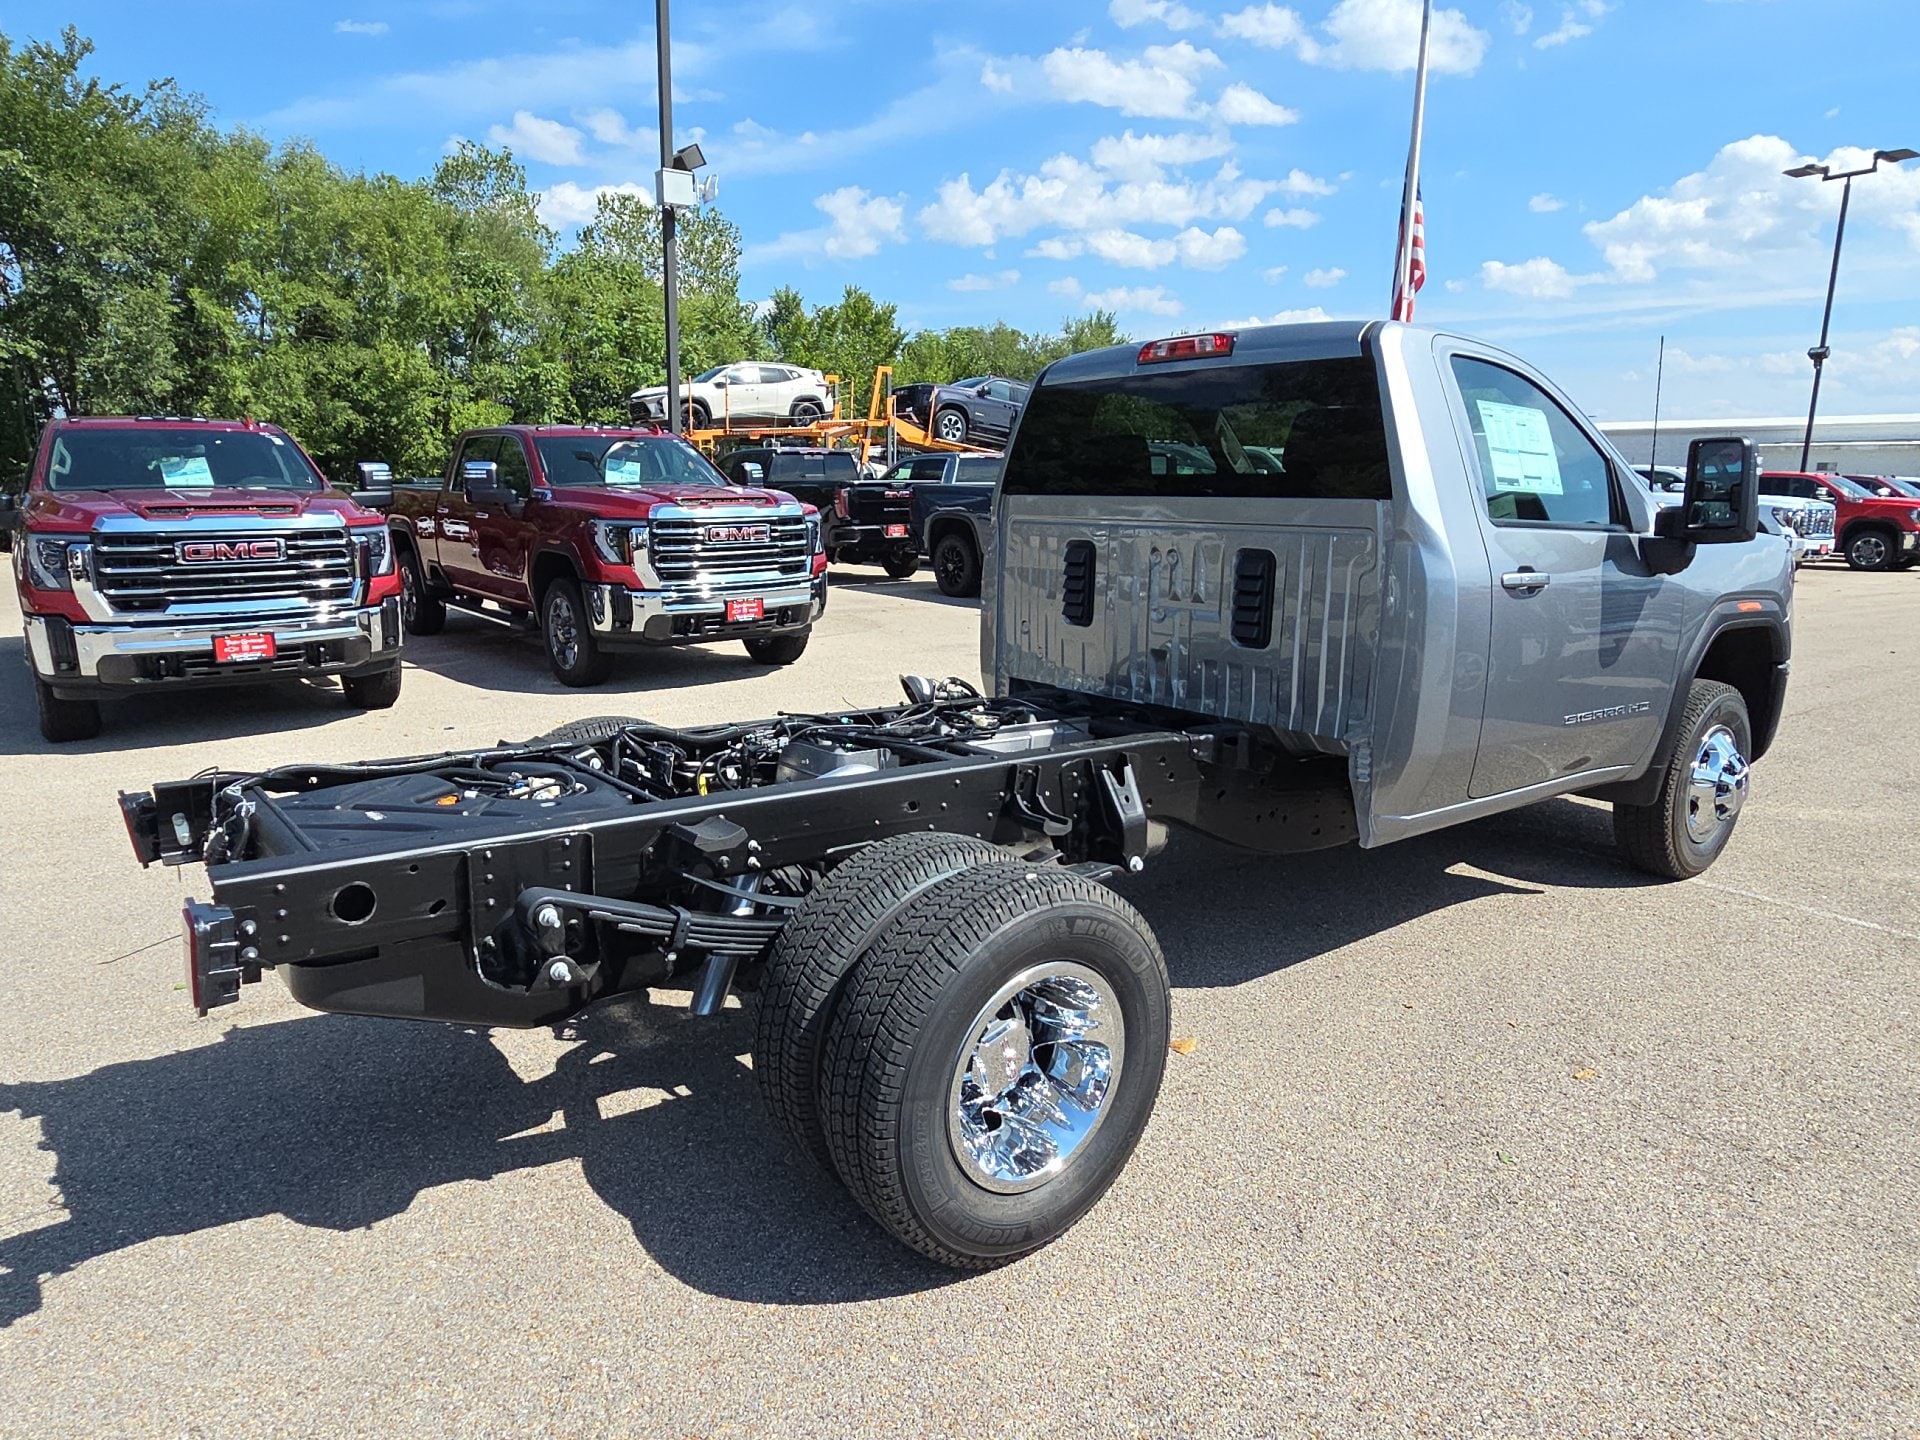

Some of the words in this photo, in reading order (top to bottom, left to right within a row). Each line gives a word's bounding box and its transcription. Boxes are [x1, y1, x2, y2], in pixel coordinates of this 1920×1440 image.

[710, 526, 768, 541] GMC
[184, 542, 279, 560] GMC
[1563, 705, 1626, 725] SIERRA
[1627, 701, 1650, 714] HD
[1072, 918, 1145, 970] MICHELIN
